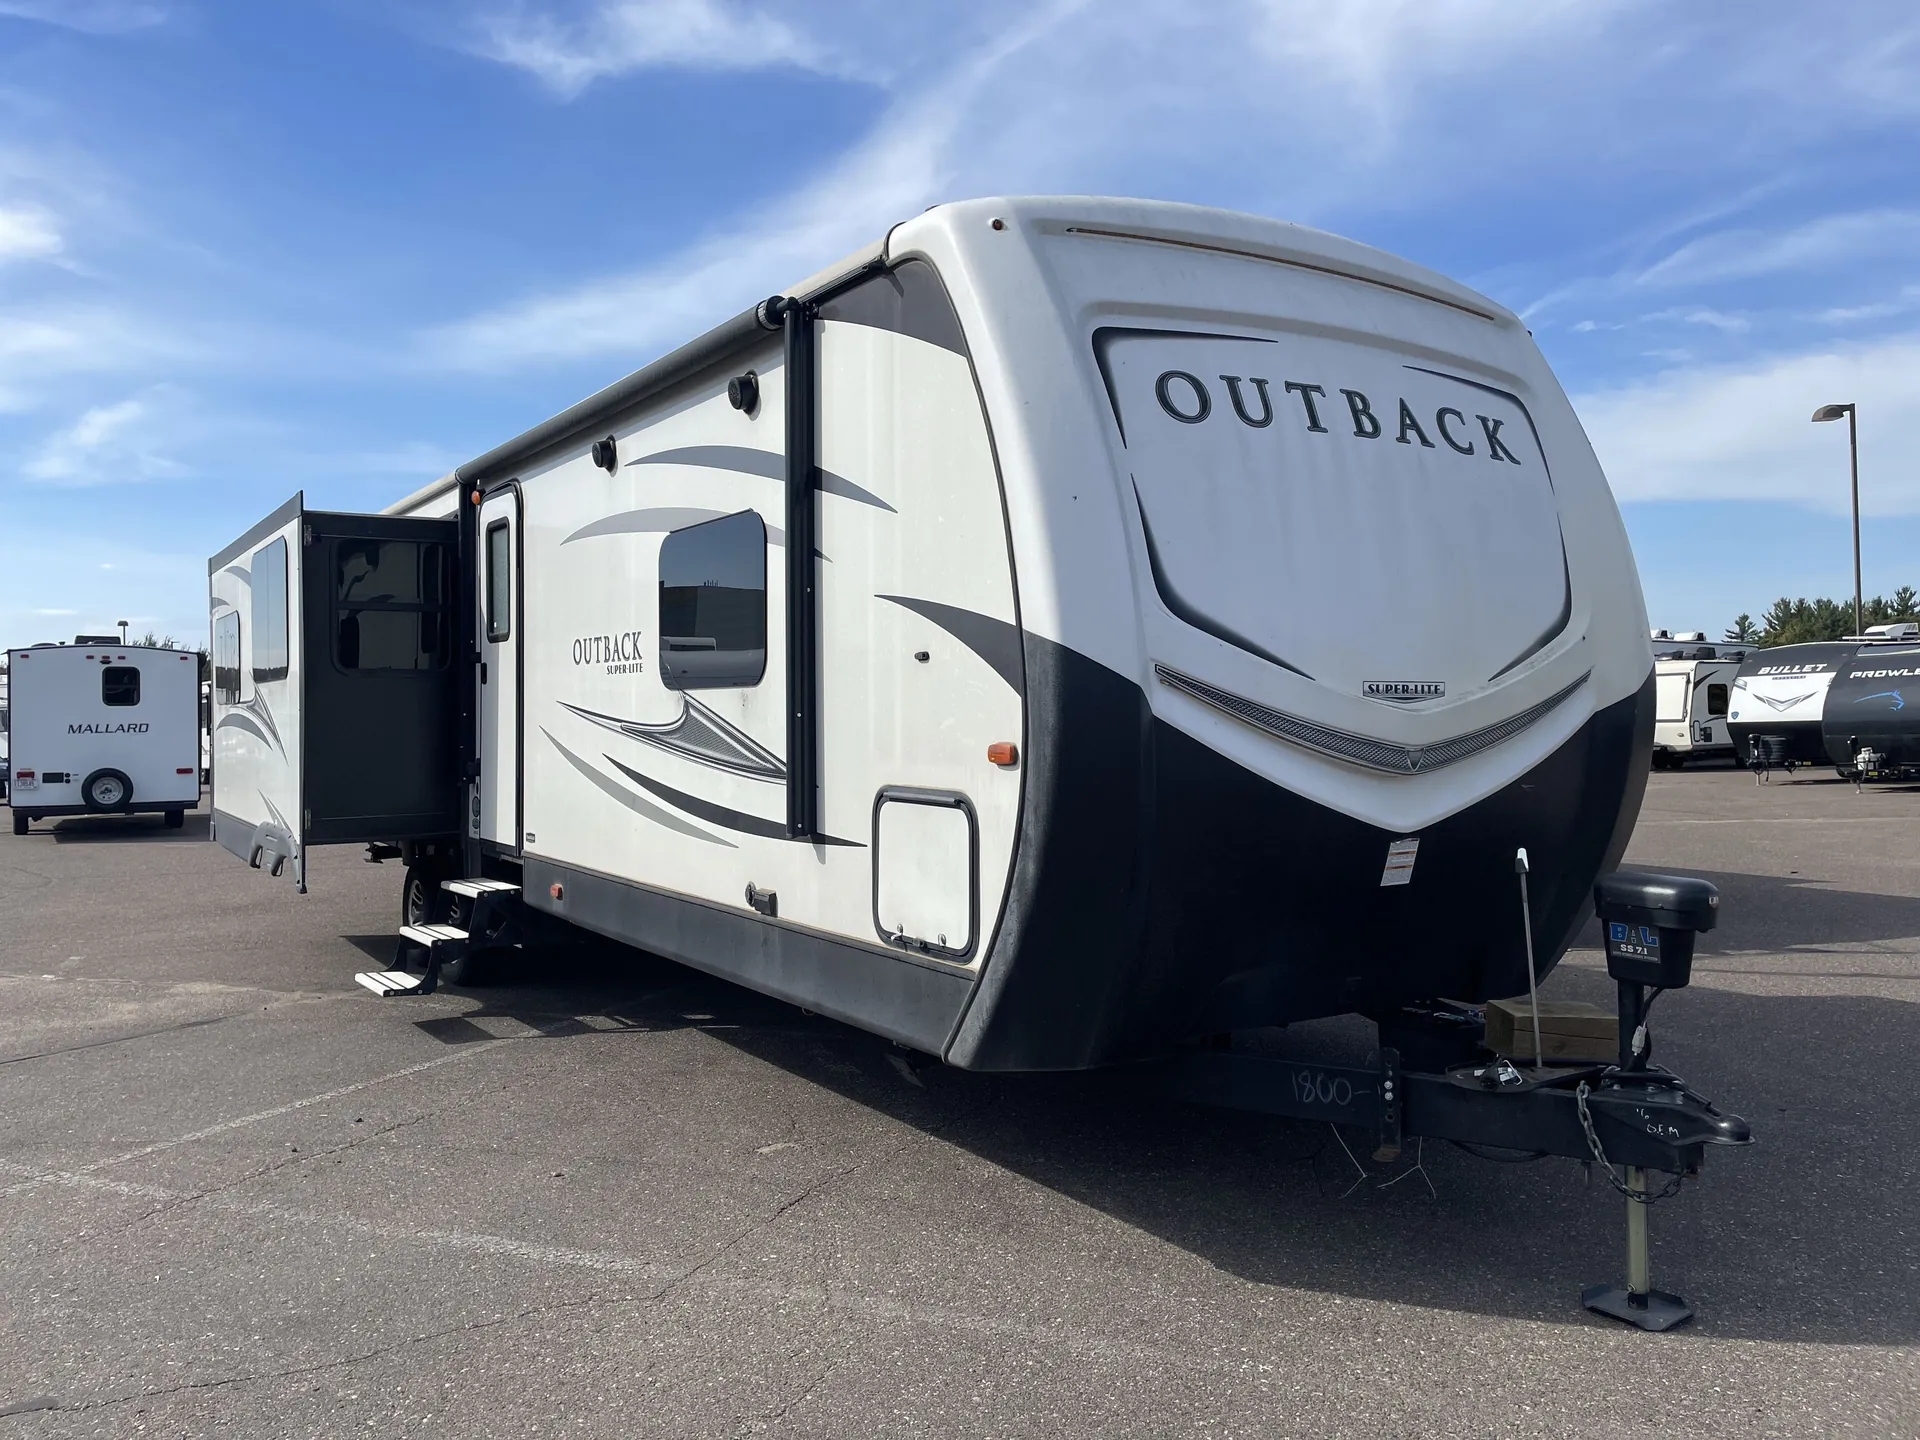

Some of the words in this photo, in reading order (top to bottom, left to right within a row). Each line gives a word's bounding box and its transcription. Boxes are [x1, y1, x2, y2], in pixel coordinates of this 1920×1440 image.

[1154, 369, 1522, 465] OUTBACK
[572, 631, 643, 666] OUTBACK
[1757, 663, 1828, 675] BULLET
[1367, 683, 1441, 695] SUPER-LITE
[68, 723, 149, 734] MALLARD
